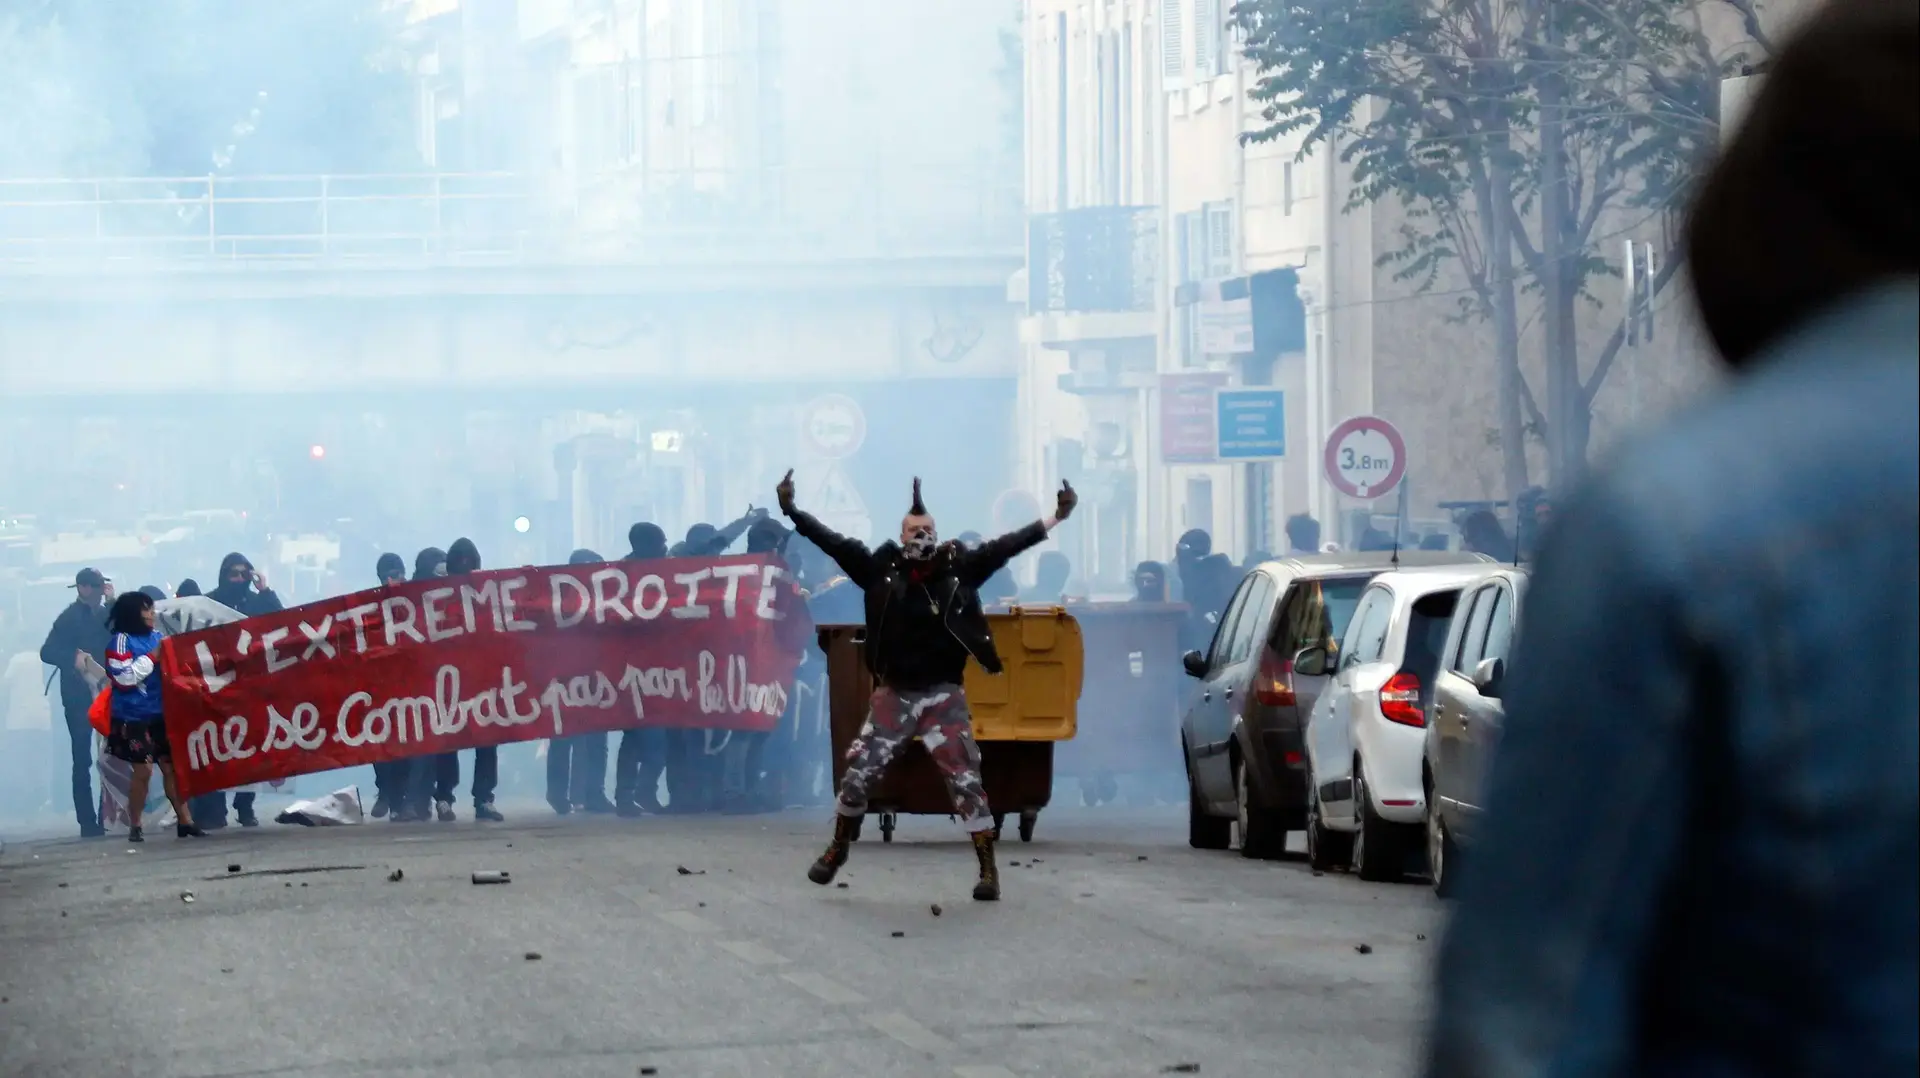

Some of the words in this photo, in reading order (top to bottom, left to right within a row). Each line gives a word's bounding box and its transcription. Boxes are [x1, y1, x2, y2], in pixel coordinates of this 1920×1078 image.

[194, 576, 537, 693] L'EXTREME
[550, 564, 788, 628] DROITE
[187, 716, 256, 770] ne
[261, 702, 326, 753] se
[540, 670, 617, 735] pas
[619, 662, 693, 719] par
[697, 650, 726, 714] les
